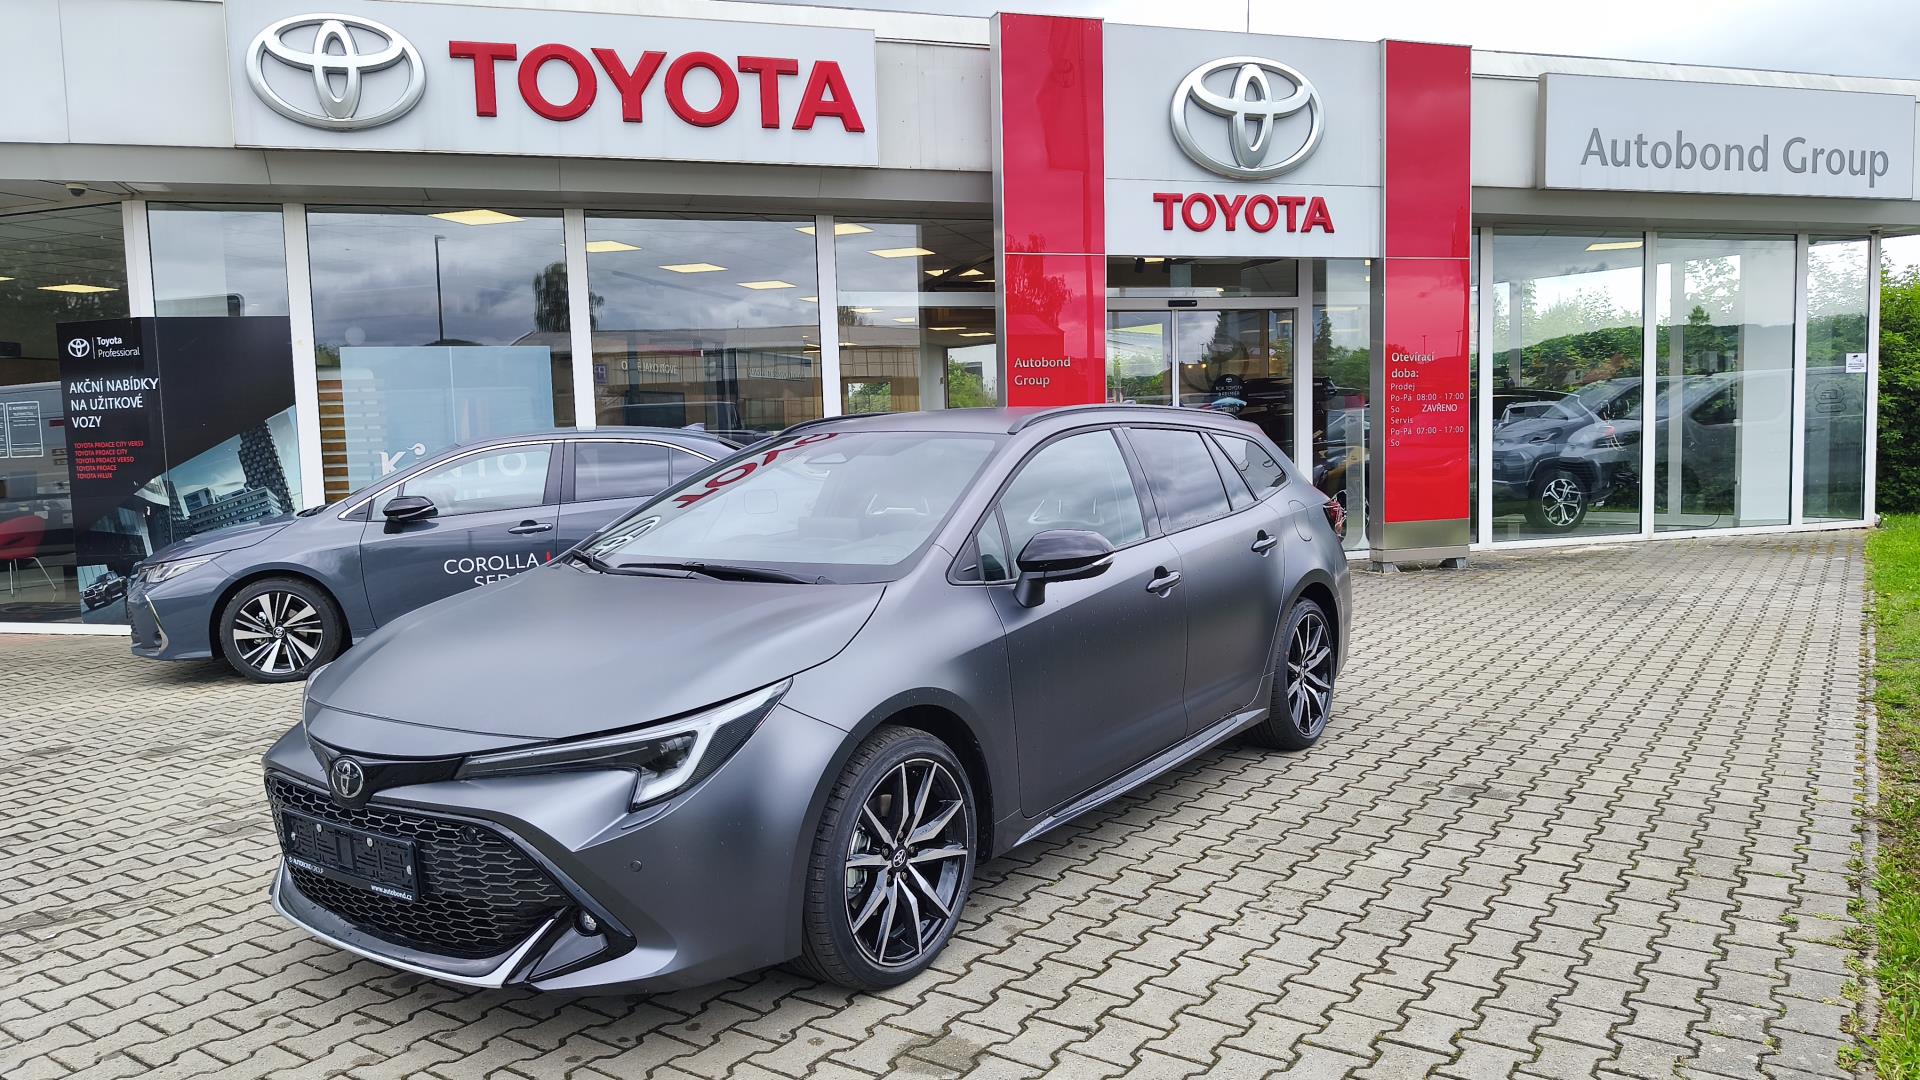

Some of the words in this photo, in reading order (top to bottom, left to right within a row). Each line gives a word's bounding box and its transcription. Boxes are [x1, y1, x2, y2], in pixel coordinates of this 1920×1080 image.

[449, 40, 865, 133] TOYOTA
[1580, 127, 1769, 172] Autobond
[1783, 137, 1889, 189] Group
[1153, 192, 1335, 234] TOYOTA
[96, 337, 122, 347] Toyota
[97, 347, 141, 358] Professional
[1014, 356, 1071, 368] Autobond
[1391, 368, 1419, 378] doba:
[69, 377, 104, 394] AKČNÍ
[106, 375, 159, 392] NABÍDKY
[1014, 375, 1050, 388] Group
[1390, 383, 1415, 391] Prodej
[70, 399, 88, 412] NA
[89, 392, 144, 410] UŽITKOVÉ
[1416, 393, 1437, 401] 08:00
[1444, 392, 1464, 400] 17:00
[1390, 405, 1400, 413] So
[1422, 402, 1458, 413] ZAVŘENO
[71, 415, 102, 428] VOZY
[1390, 416, 1414, 424] Servis
[1416, 426, 1437, 435] 07:00
[1444, 425, 1464, 433] 17:00
[1390, 439, 1400, 447] So
[443, 552, 540, 575] COROLLA
